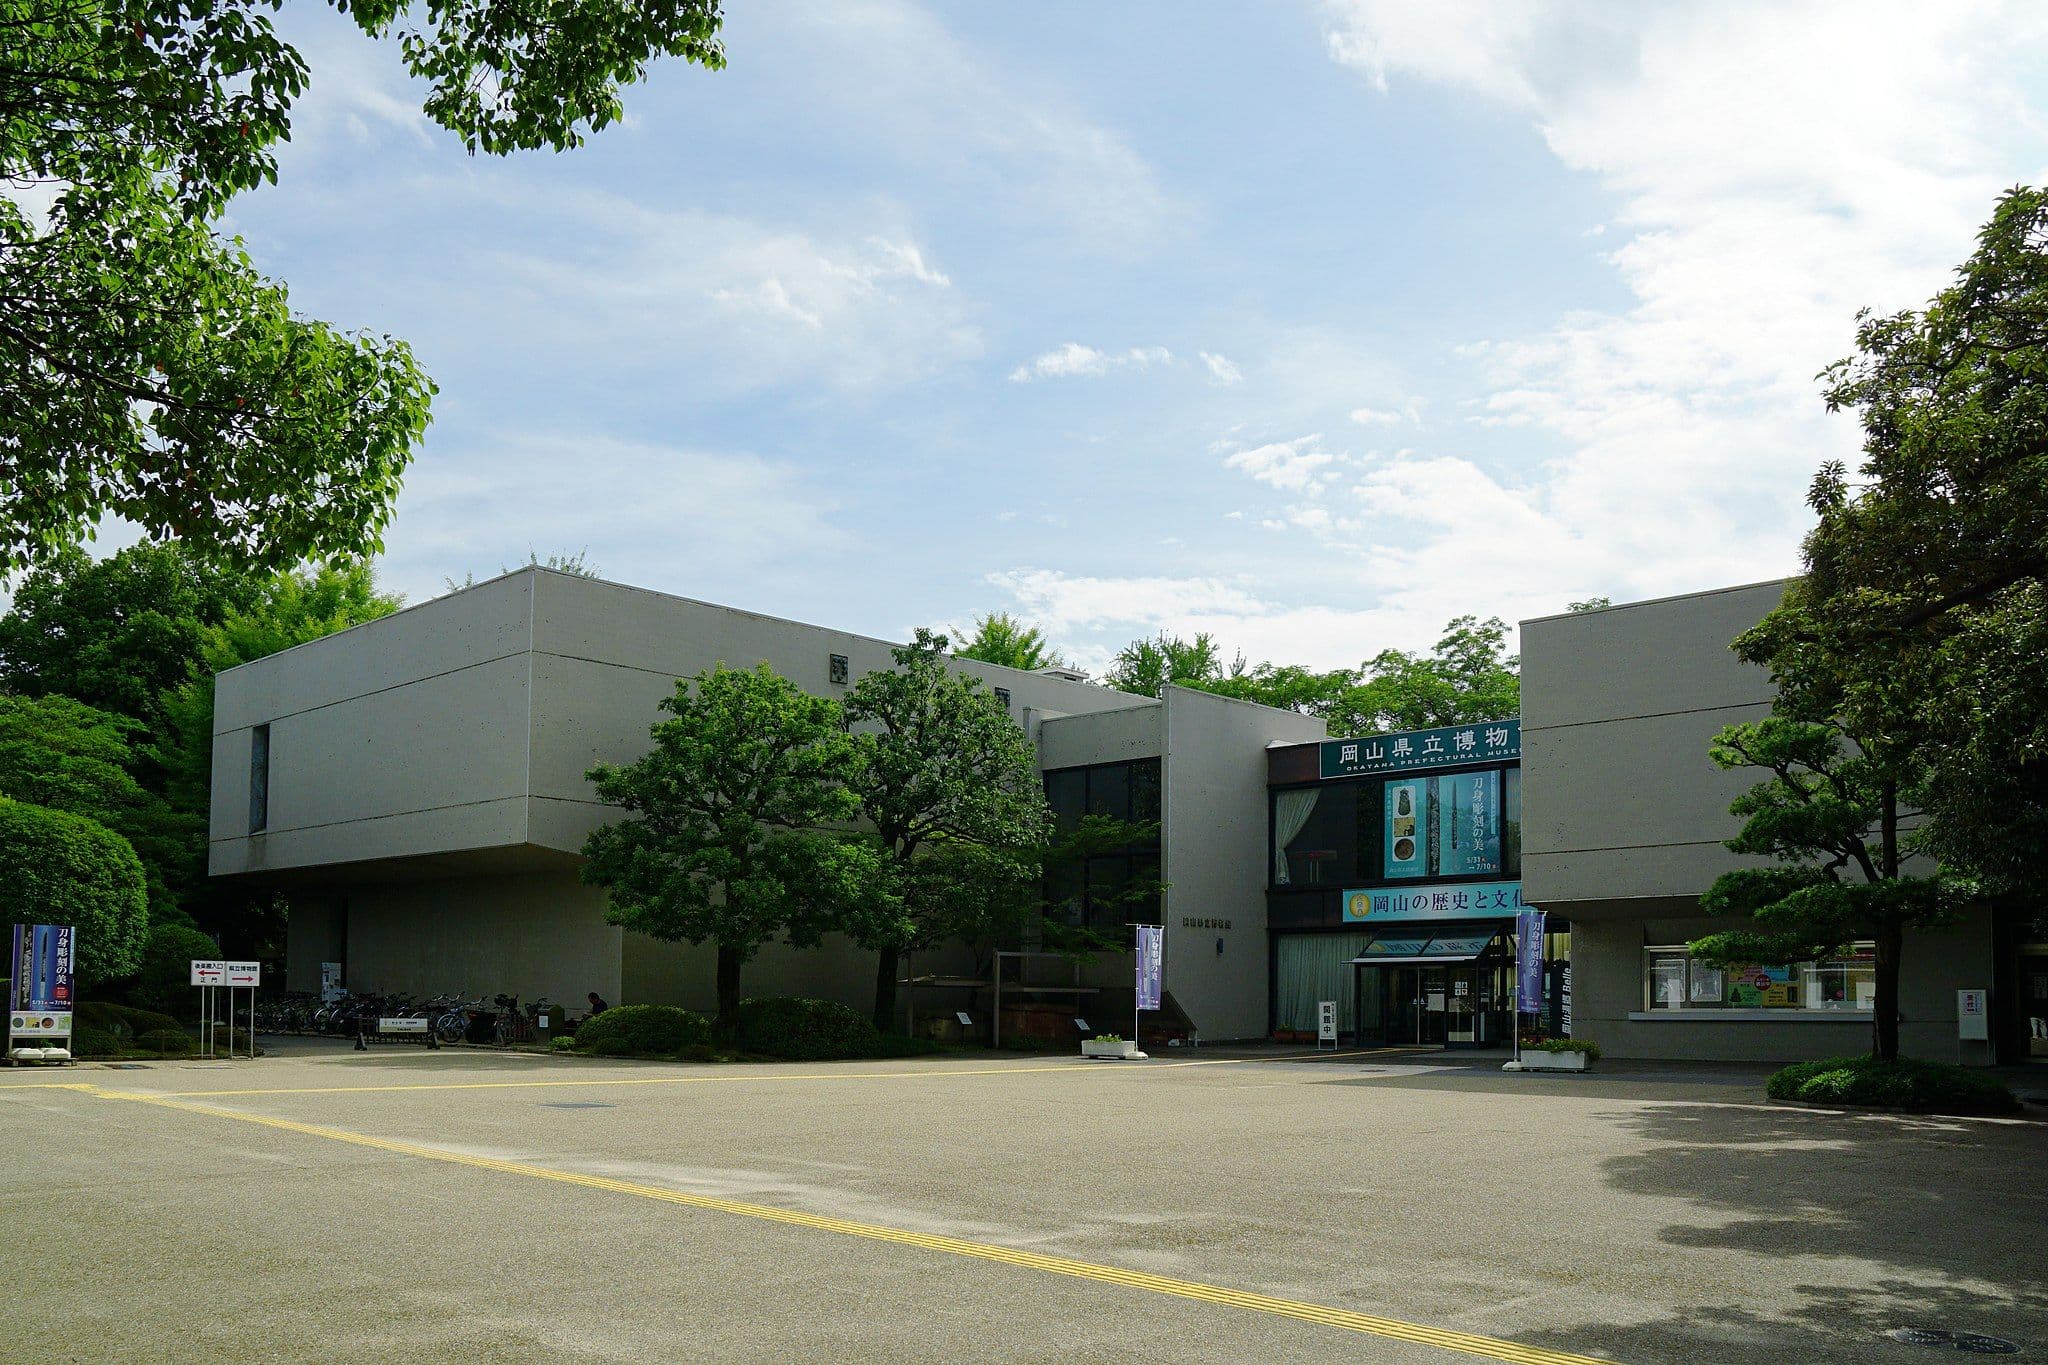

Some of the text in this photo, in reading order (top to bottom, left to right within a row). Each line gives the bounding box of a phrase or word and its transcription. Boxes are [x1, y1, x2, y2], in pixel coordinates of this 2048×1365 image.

[1339, 727, 1521, 764] 岡山県立博物
[1346, 748, 1521, 771] OKAYAMA PREFECTURAL MUSE
[1472, 777, 1484, 851] 刀身彫刻の美
[55, 927, 69, 985] 刀身彫刻の美
